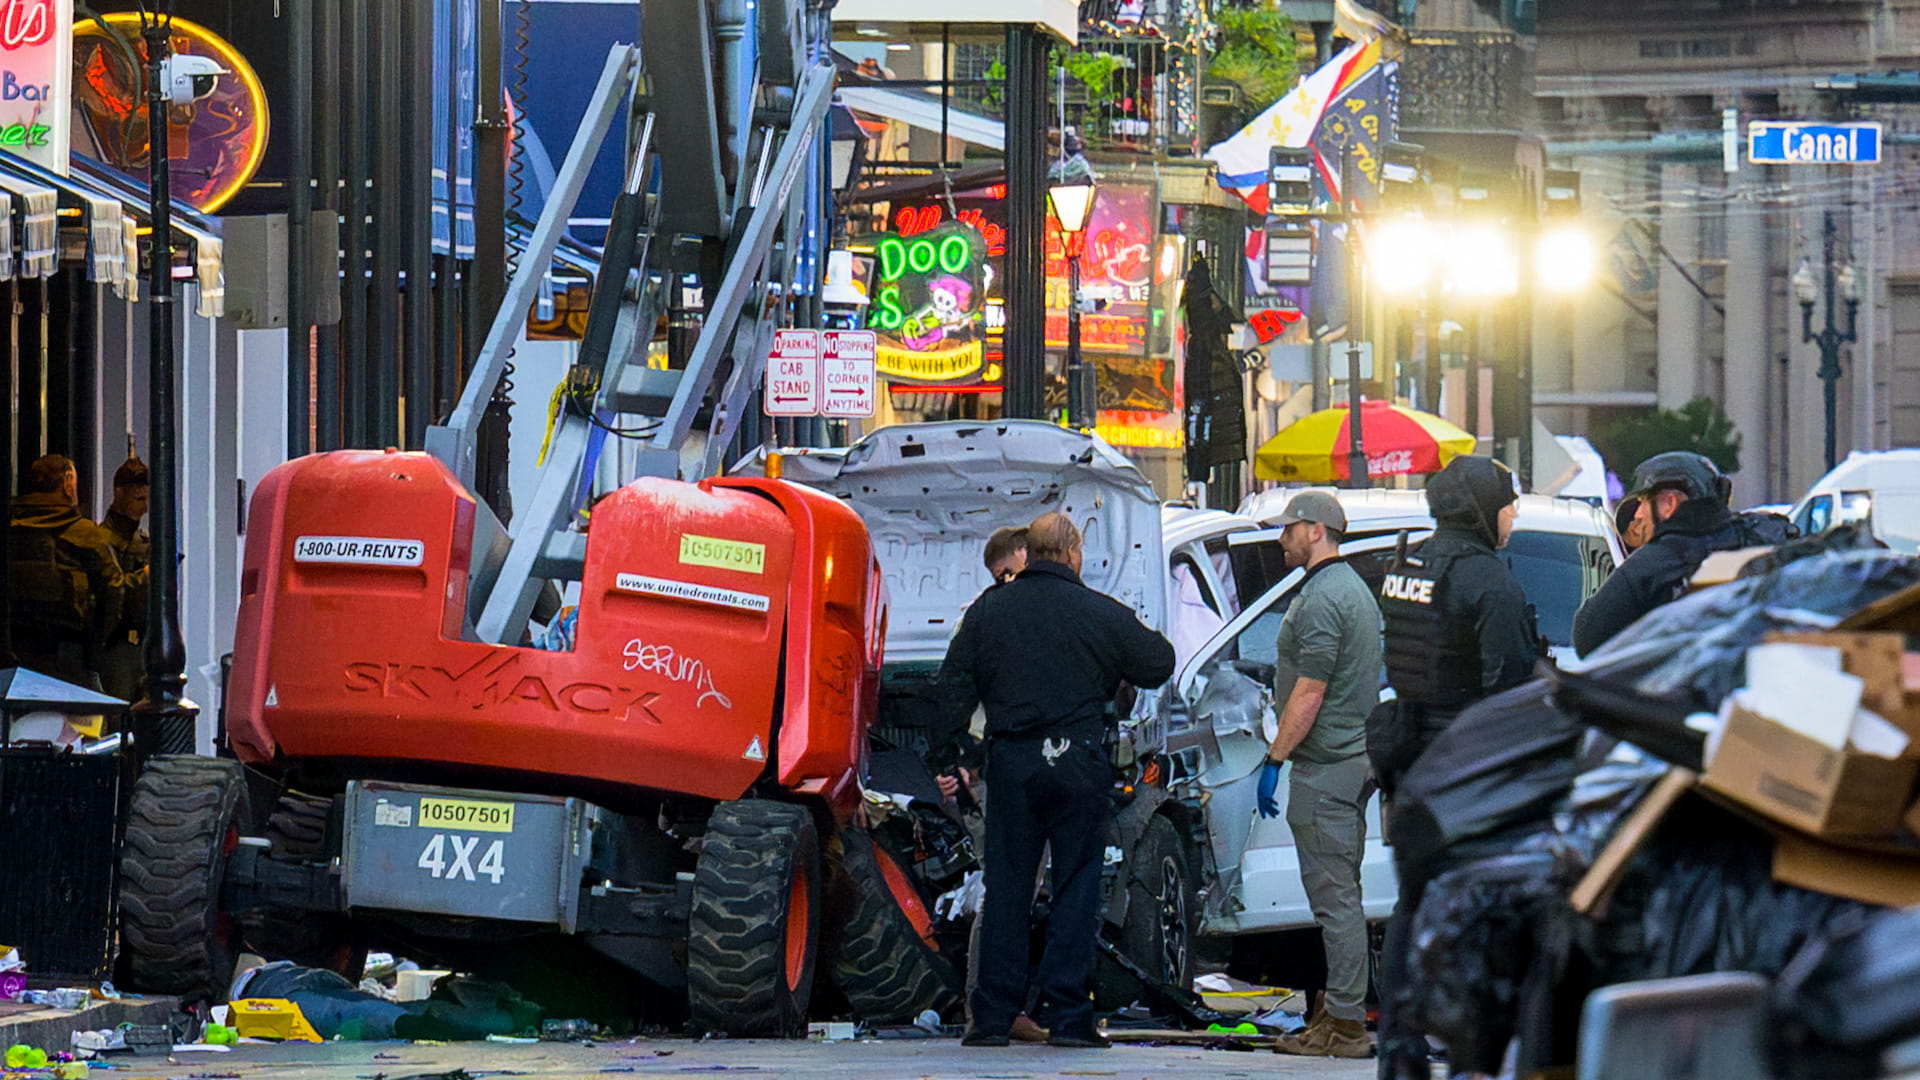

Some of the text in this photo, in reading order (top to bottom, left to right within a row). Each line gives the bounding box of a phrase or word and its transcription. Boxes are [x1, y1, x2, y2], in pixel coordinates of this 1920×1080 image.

[3, 70, 50, 101] Bar
[1783, 127, 1858, 161] Canal
[781, 339, 817, 350] PARKING
[823, 334, 874, 355] NO STOPPING
[780, 361, 804, 376] CAB
[843, 361, 856, 371] TO
[887, 355, 907, 370] BE
[909, 358, 944, 374] WITH
[949, 350, 979, 372] YOU
[773, 380, 811, 394] STAND
[827, 374, 869, 384] CORNER
[826, 400, 870, 412] ANYTIME
[298, 541, 419, 560] 1-800-UR-RENTS
[681, 540, 763, 566] 10507501
[620, 576, 766, 610] www.unitedrentals.com
[345, 651, 662, 725] SKYJACK
[421, 803, 512, 825] 10507501
[418, 833, 506, 885] 4X4
